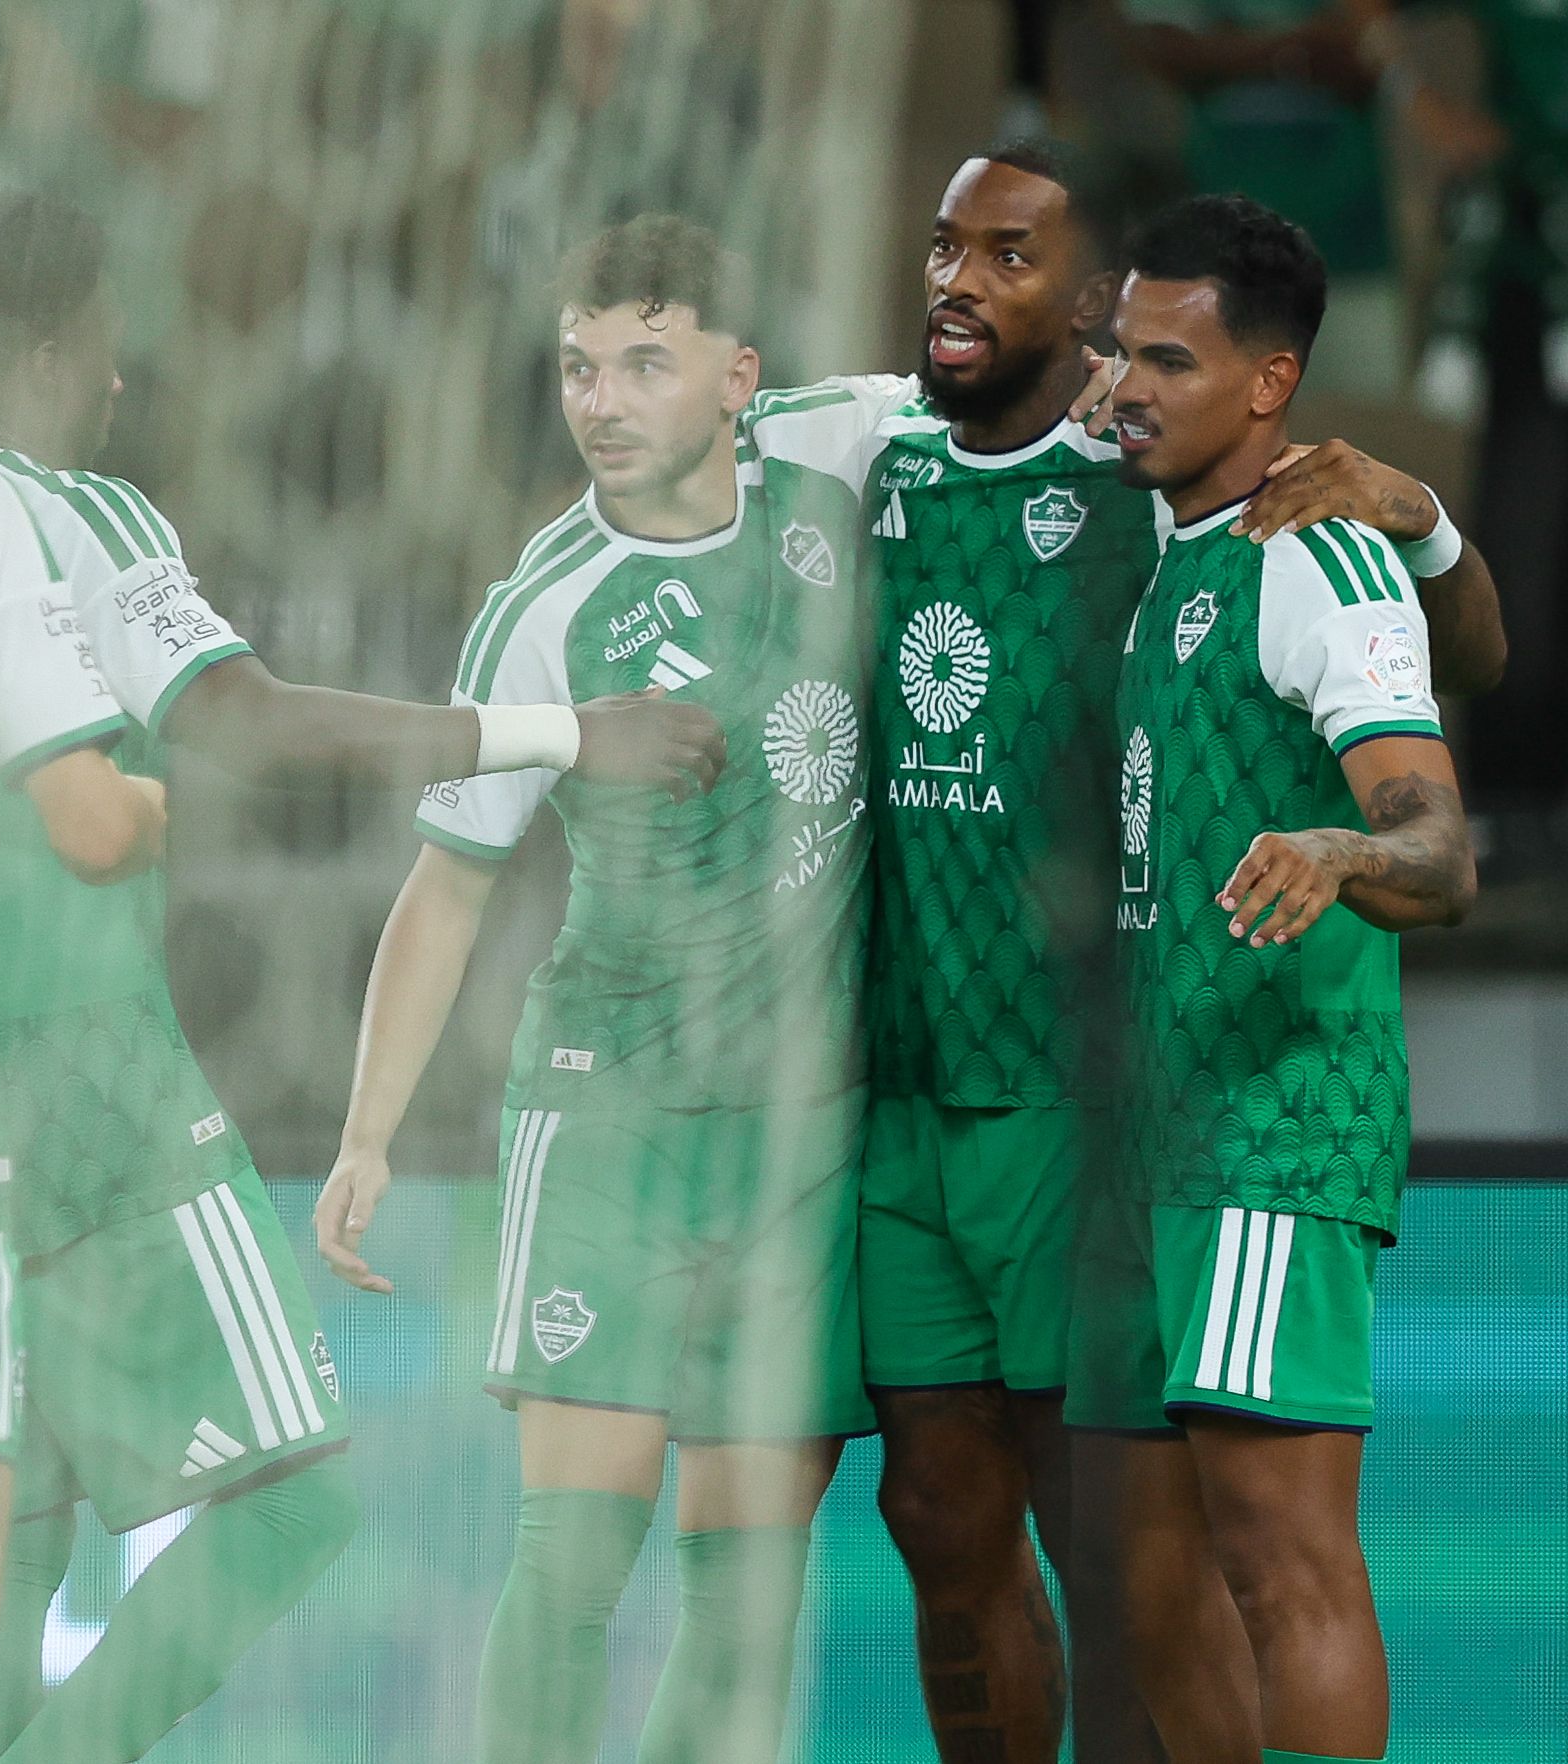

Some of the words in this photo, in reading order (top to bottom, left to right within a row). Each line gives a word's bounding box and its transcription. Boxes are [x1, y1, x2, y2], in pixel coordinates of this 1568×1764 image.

[608, 600, 651, 639] الديار
[603, 620, 662, 663] العربية
[1389, 656, 1417, 672] RSL
[888, 778, 1005, 813] AMAALA
